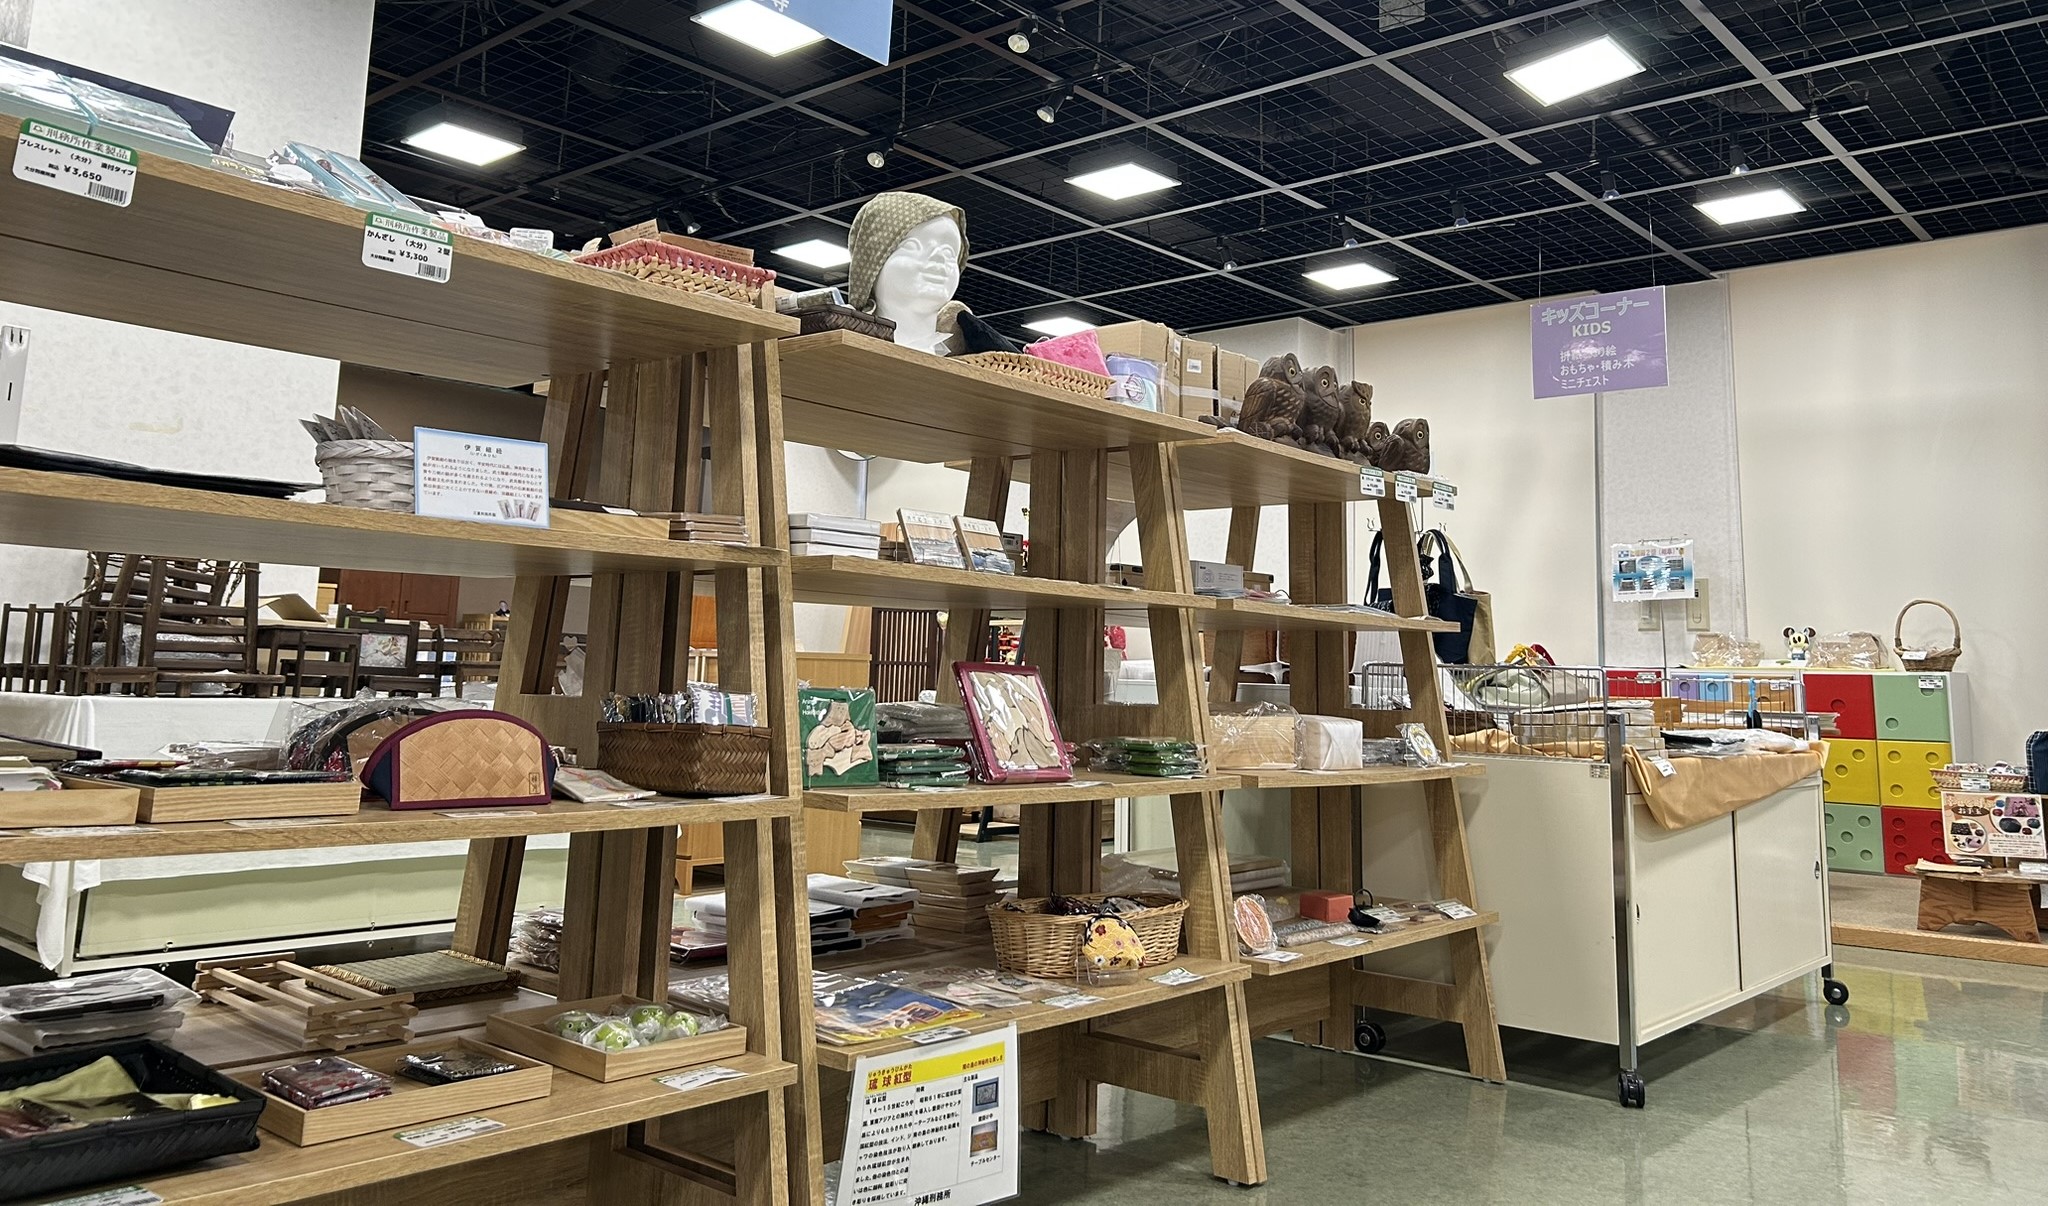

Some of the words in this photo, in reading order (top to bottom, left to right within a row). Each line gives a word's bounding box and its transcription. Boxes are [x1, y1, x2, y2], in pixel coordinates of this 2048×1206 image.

[19, 139, 61, 155] ブレスレット
[46, 128, 128, 160] 刑務所作業製品
[64, 165, 102, 181] ¥3,650
[366, 230, 395, 243] かんざし
[384, 219, 447, 241] 刑務所作業製品
[399, 250, 428, 262] ¥3,300
[1541, 296, 1649, 326] キッズコーナー
[1572, 320, 1611, 337] KIDS
[1561, 374, 1609, 389] ミニチェスト
[868, 1063, 912, 1078] りゅうきゅうびんがた
